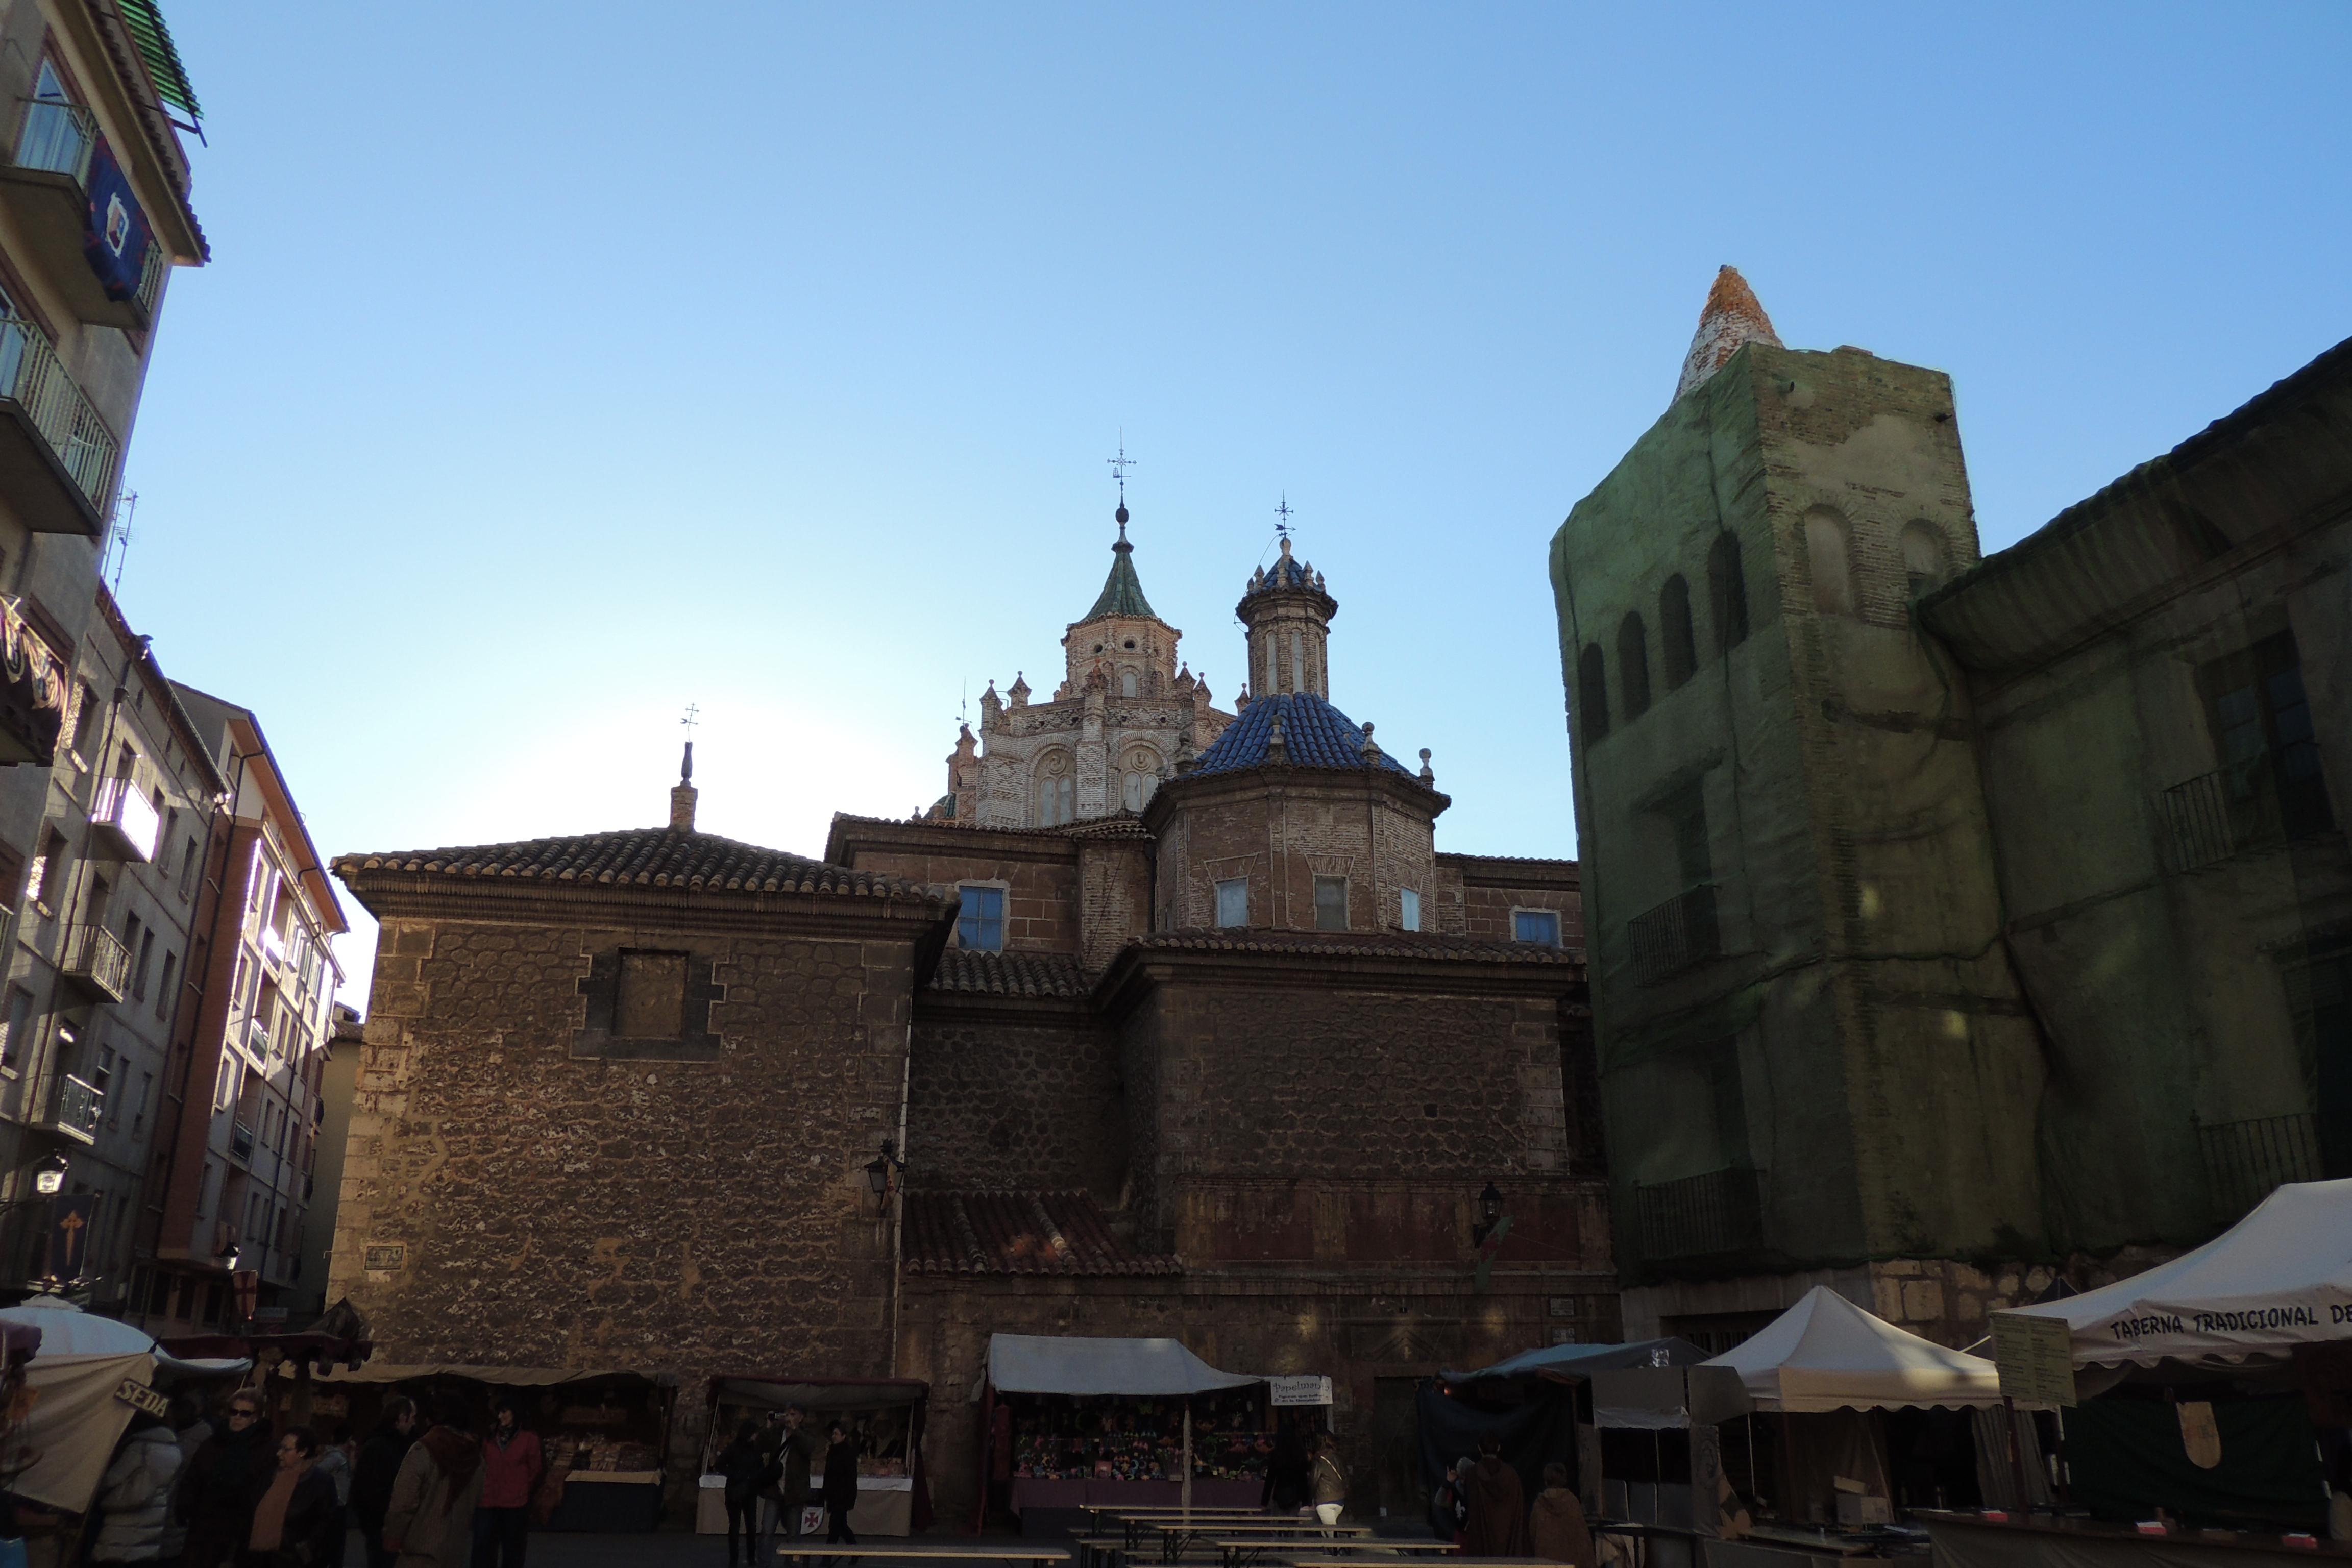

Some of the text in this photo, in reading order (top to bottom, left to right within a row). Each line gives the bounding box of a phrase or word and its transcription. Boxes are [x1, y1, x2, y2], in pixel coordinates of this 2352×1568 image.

[2110, 1315, 2184, 1340] TABERNA
[2193, 1306, 2319, 1332] TRADICIONAL
[115, 1380, 169, 1418] SEDA
